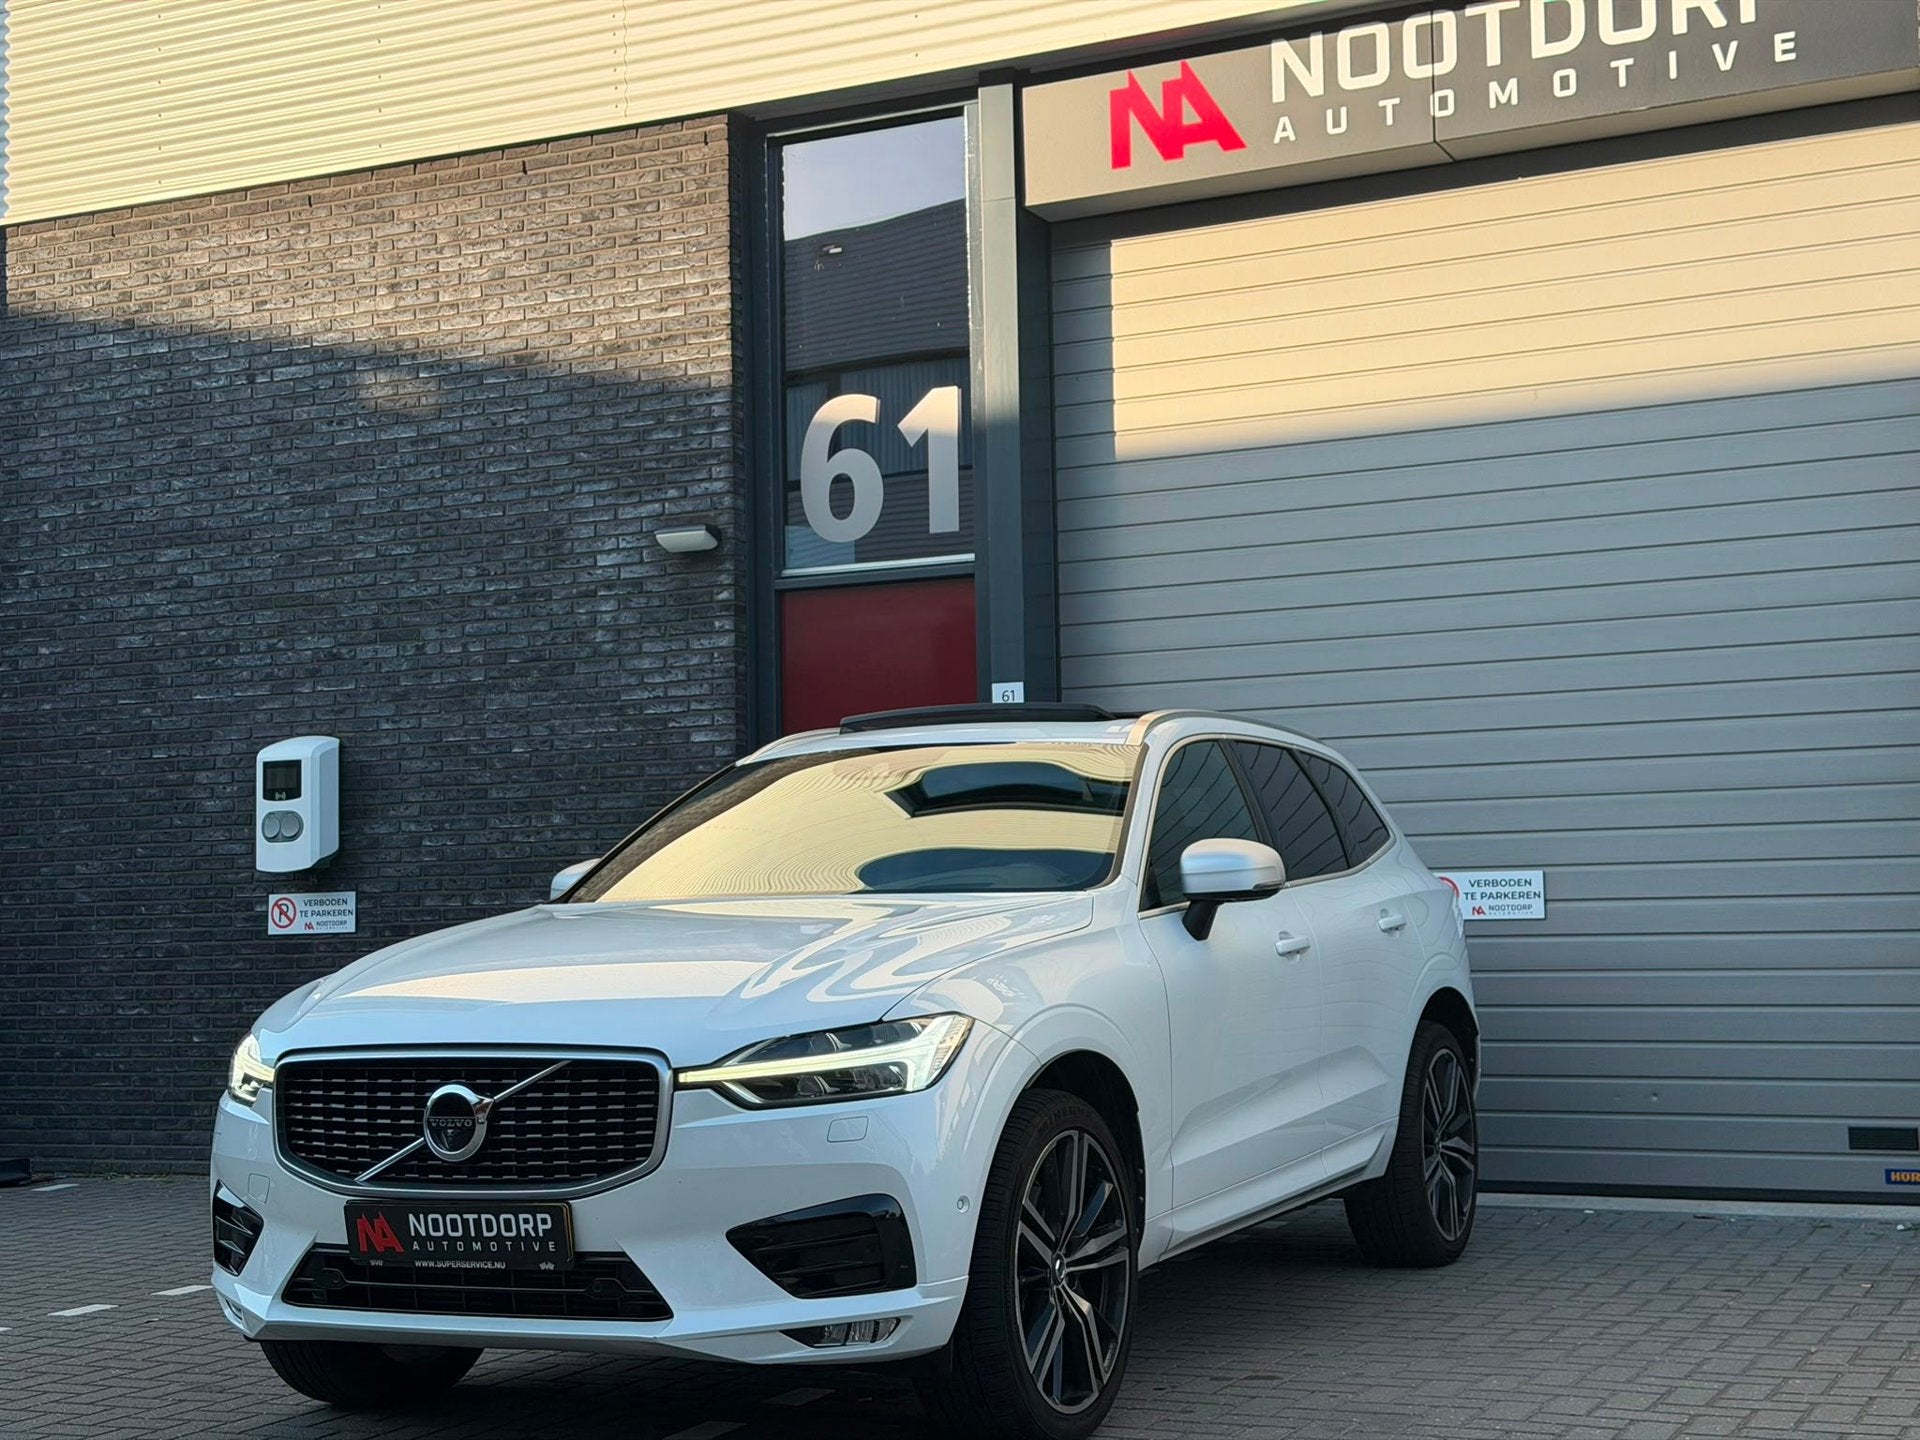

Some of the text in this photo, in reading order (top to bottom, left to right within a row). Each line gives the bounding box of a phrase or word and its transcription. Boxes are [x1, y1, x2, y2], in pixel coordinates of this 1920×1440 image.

[1273, 31, 1797, 144] AUTOMOTIVE
[800, 386, 961, 543] 61
[1001, 689, 1016, 703] 61
[1468, 878, 1532, 888] VERBODEN
[1463, 890, 1541, 900] TE PARKEREN
[303, 898, 348, 907] VERBODEN
[1488, 903, 1533, 911] NOOTDORP
[300, 909, 354, 918] TE PARKEREN
[408, 1213, 552, 1237] NOOTDORP
[412, 1241, 556, 1252] AUTOMOTIVE
[414, 1260, 506, 1269] WWW.SUPERSERVICE.NU
